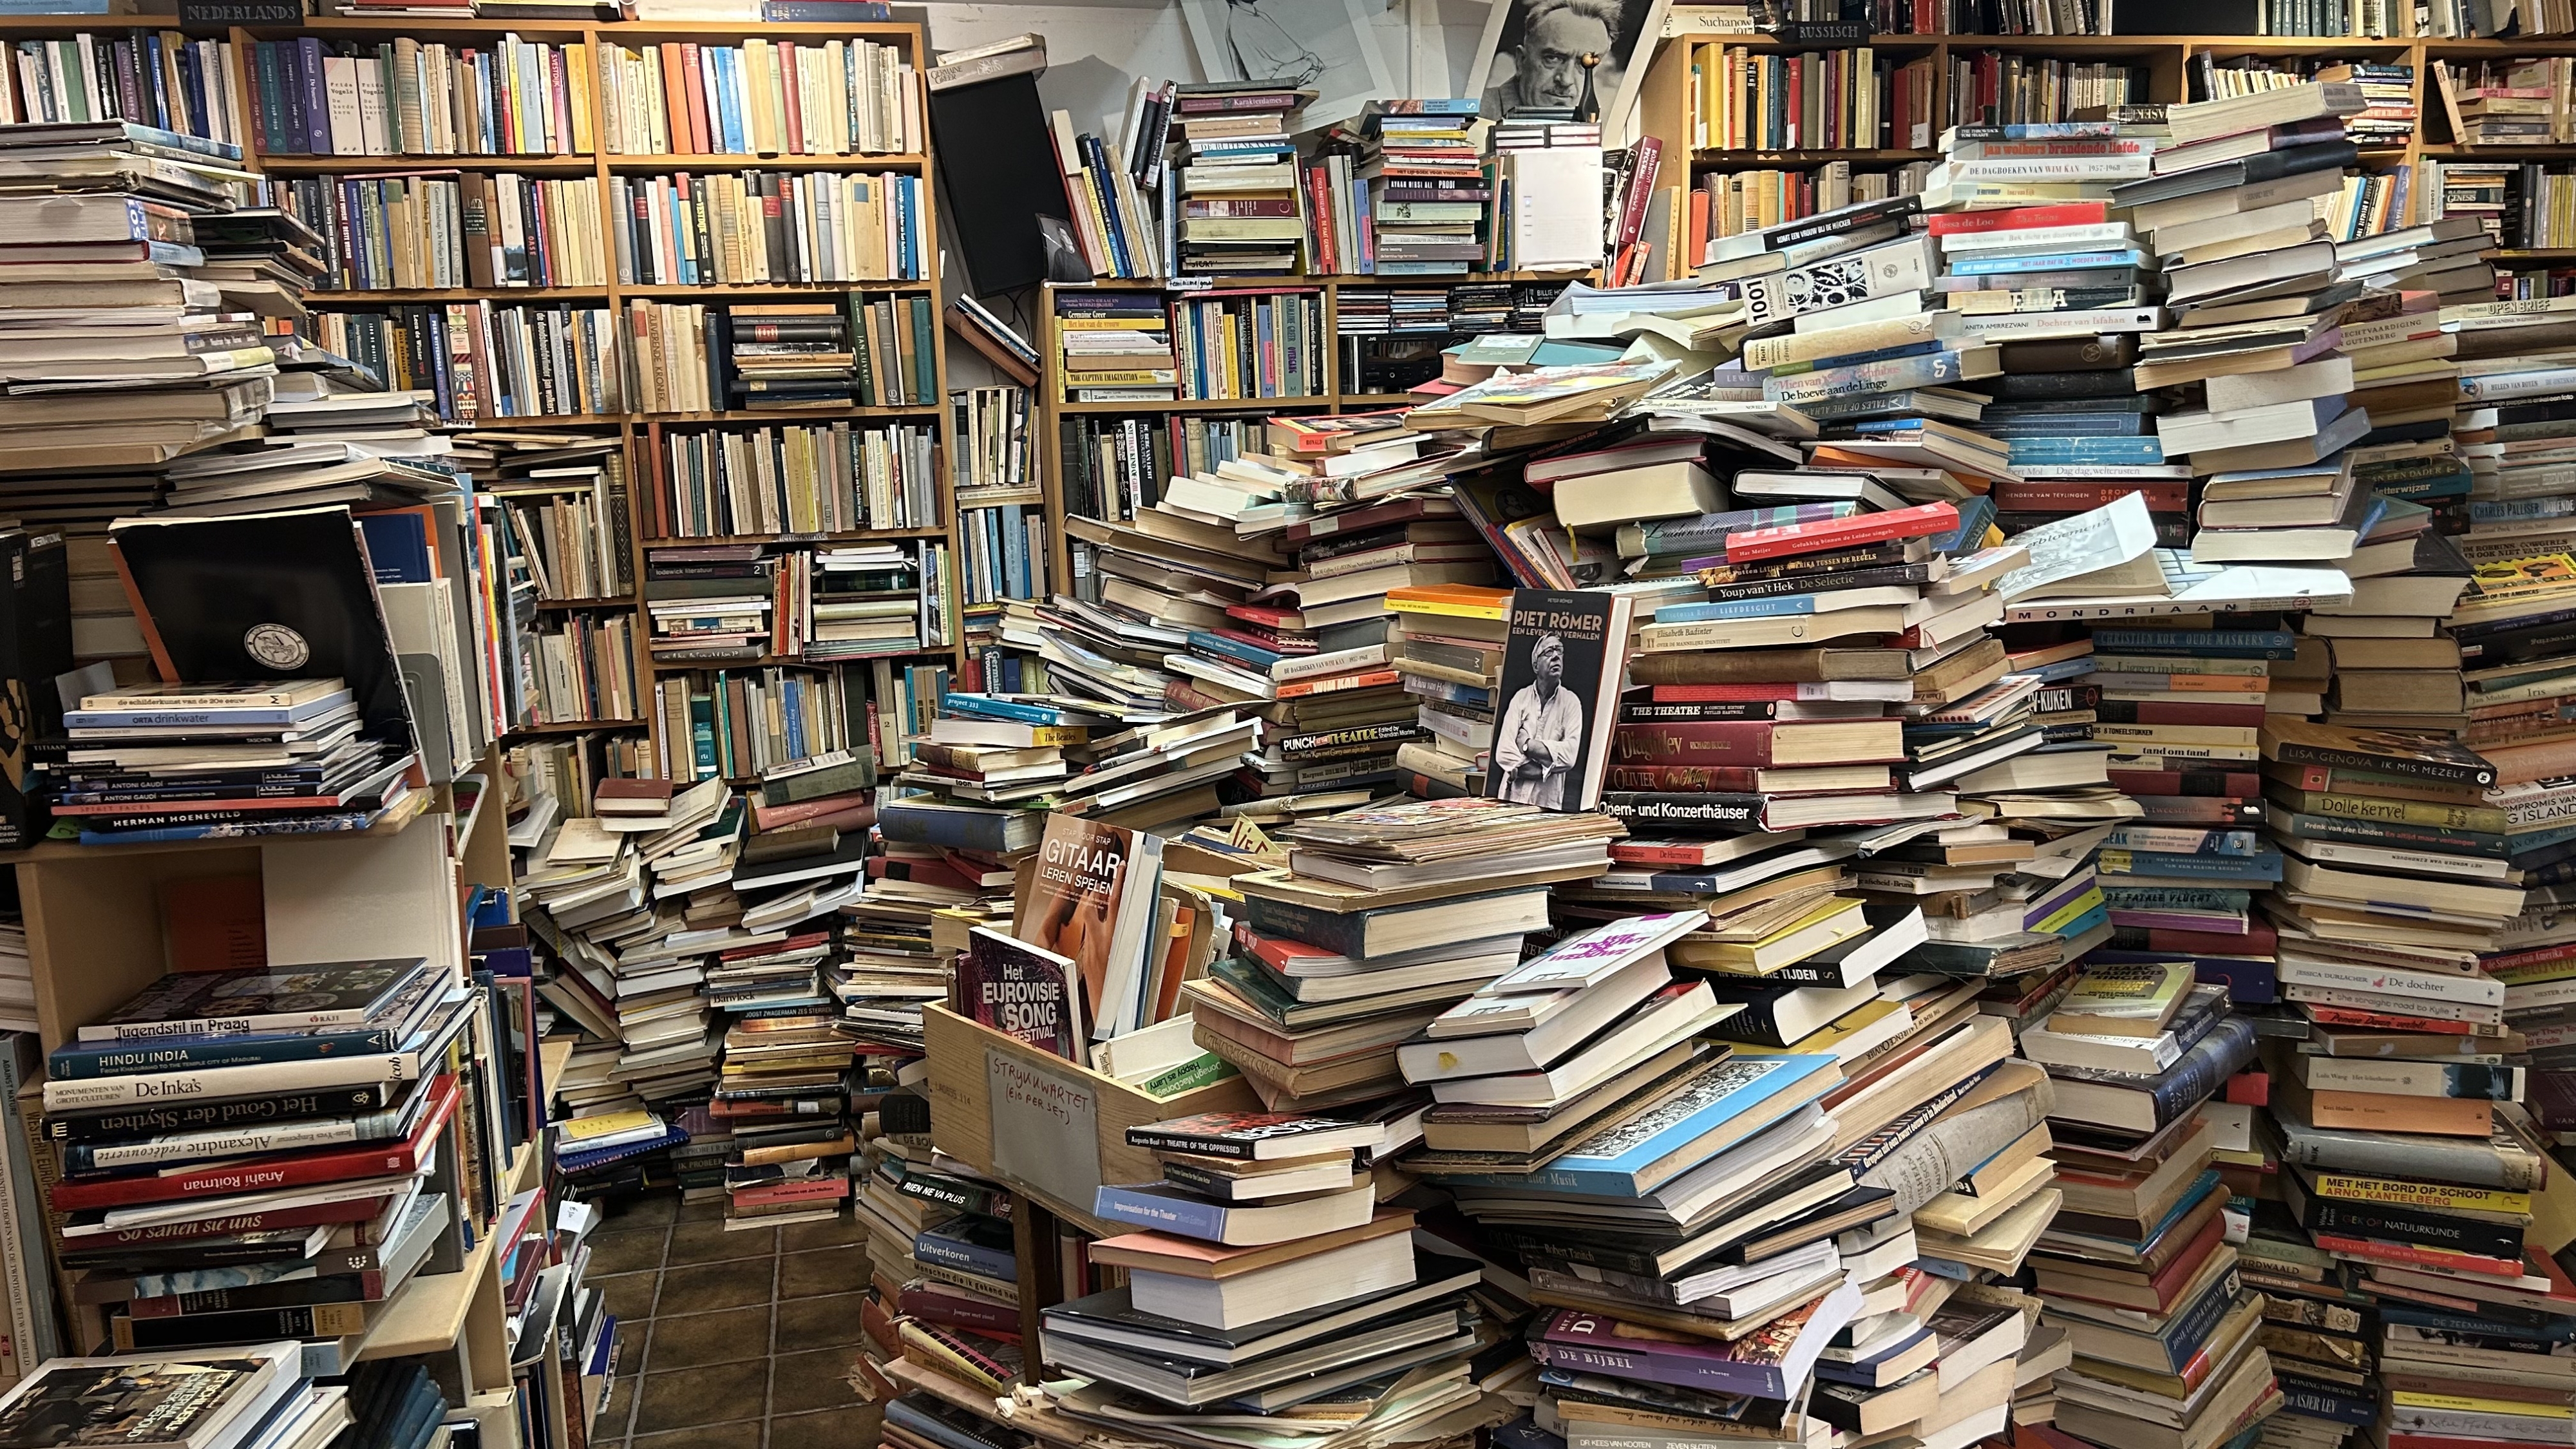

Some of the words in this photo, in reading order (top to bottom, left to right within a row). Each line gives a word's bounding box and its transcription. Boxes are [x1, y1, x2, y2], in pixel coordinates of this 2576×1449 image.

[187, 5, 297, 21] NEDERLANDS
[1700, 15, 1752, 27] Suchanow
[1799, 26, 1859, 39] RUSSISCH
[1233, 97, 1282, 106] Karakterdames
[1984, 143, 2001, 157] jan
[2003, 141, 2047, 154] wolkers
[2048, 141, 2107, 154] brandende
[2109, 138, 2140, 153] liefde
[1969, 167, 1980, 175] DE
[1982, 166, 2027, 175] DAGBOEKEN
[2029, 165, 2043, 174] VAN
[2045, 165, 2061, 173] WIM
[2063, 165, 2079, 173] KAN
[2447, 194, 2476, 203] GENESIS
[1746, 279, 1769, 323] 1001
[2487, 302, 2517, 315] OPEN
[2519, 299, 2550, 313] BRIEF
[2037, 319, 2072, 328] Dochter
[2092, 316, 2125, 325] Isfahan
[649, 314, 662, 363] ZUIVERENDE
[2345, 332, 2397, 348] GUTENBERG
[654, 366, 666, 402] KRONIEK
[1070, 373, 1079, 382] THE
[1080, 373, 1103, 382] CAPTIVE
[1104, 373, 1138, 382] IMAGINATION
[1781, 391, 1796, 402] De
[1797, 388, 1826, 399] hoeve
[1828, 386, 1845, 395] aan
[1848, 381, 1858, 392] de
[1858, 378, 1888, 392] Linge
[1832, 404, 1848, 413] THE
[1849, 403, 1859, 412] OF
[1861, 399, 1886, 409] TALES
[2474, 501, 2506, 518] CHARLES
[2507, 502, 2540, 515] PALLISER
[753, 566, 761, 575] 2
[1720, 587, 1745, 599] Youp
[1774, 581, 1794, 592] Hek
[1800, 578, 1813, 589] De
[1815, 574, 1855, 587] Selectie
[1720, 603, 1776, 614] LIEFDESGIFT
[2018, 603, 2237, 620] MONDRIAAN
[1513, 610, 1546, 627] PIET
[1549, 611, 1602, 631] RÖMER
[2101, 632, 2153, 645] CHRISTIEN
[2157, 633, 2175, 645] KOK
[2215, 634, 2264, 646] MASKERS
[947, 699, 968, 707] project
[1632, 706, 1652, 716] THE
[1654, 706, 1701, 715] THEATRE
[155, 714, 209, 724] drinkwater
[1044, 733, 1055, 742] The
[1056, 732, 1076, 741] Beatles
[1283, 736, 1316, 751] PUNCH
[1329, 728, 1378, 744] THEATRE
[2143, 746, 2166, 756] tand
[2186, 748, 2210, 757] tand
[2288, 748, 2314, 760] LISA
[2319, 752, 2372, 768] GENOVA
[2397, 763, 2416, 772] MIS
[2421, 766, 2466, 779] MEZELF
[1638, 803, 1660, 817] und
[1662, 802, 1749, 820] Konzerthäuser
[2321, 798, 2358, 814] Dolle
[2361, 801, 2406, 820] kervel
[113, 817, 165, 828] HERMAN
[169, 811, 241, 822] HOENEVELD
[1046, 838, 1121, 880] GITAAR
[1041, 865, 1072, 886] LEREN
[1074, 874, 1114, 896] SPELEN
[1003, 963, 1023, 981] Het
[1780, 969, 1818, 980] TIJDEN
[2296, 969, 2322, 978] JESSICA
[2324, 972, 2369, 983] DURLACHER
[2389, 978, 2403, 987] De
[2407, 980, 2445, 992] dochter
[982, 981, 1060, 1005] EUROVISIE
[1005, 1001, 1057, 1032] SONG
[114, 1023, 187, 1041] Jugendstil
[190, 1021, 203, 1033] in
[207, 1019, 250, 1034] Praag
[99, 1054, 145, 1066] HINDU
[149, 1050, 188, 1063] INDIA
[135, 1083, 158, 1097] De
[161, 1078, 202, 1095] Inka's
[222, 1100, 277, 1118] Goud
[283, 1096, 317, 1113] Het
[1026, 1095, 1045, 1113] PER
[1932, 1089, 1957, 1114] Nederland
[100, 1110, 178, 1132] Skythen
[184, 1105, 217, 1121] der
[97, 1146, 182, 1160] redécouverte
[187, 1135, 272, 1157] Alexandrie
[1167, 1139, 1188, 1150] THEATRE
[1198, 1142, 1208, 1151] THE
[1209, 1143, 1240, 1155] OPPRESSED
[183, 1176, 241, 1191] Roitman
[1550, 1173, 1577, 1186] Musik
[903, 1182, 924, 1193] RIEN
[922, 1187, 936, 1197] NE
[934, 1189, 945, 1199] VA
[944, 1193, 965, 1204] PLUS
[2325, 1188, 2361, 1197] ARNO
[2365, 1190, 2451, 1206] KANTELBERG
[2327, 1178, 2353, 1188] MET
[2355, 1180, 2380, 1189] HET
[2382, 1182, 2417, 1193] BORD
[2420, 1186, 2437, 1195] OP
[2439, 1188, 2491, 1200] SCHOOT
[1113, 1201, 1143, 1216] Improvisation
[1159, 1209, 1177, 1221] Theater
[2385, 1220, 2461, 1239] NATUURKUNDE
[919, 1242, 970, 1262] Uitverkoren
[2509, 1341, 2540, 1351] woede
[1558, 1350, 1578, 1361] DE
[1585, 1353, 1634, 1370] BIJBEL
